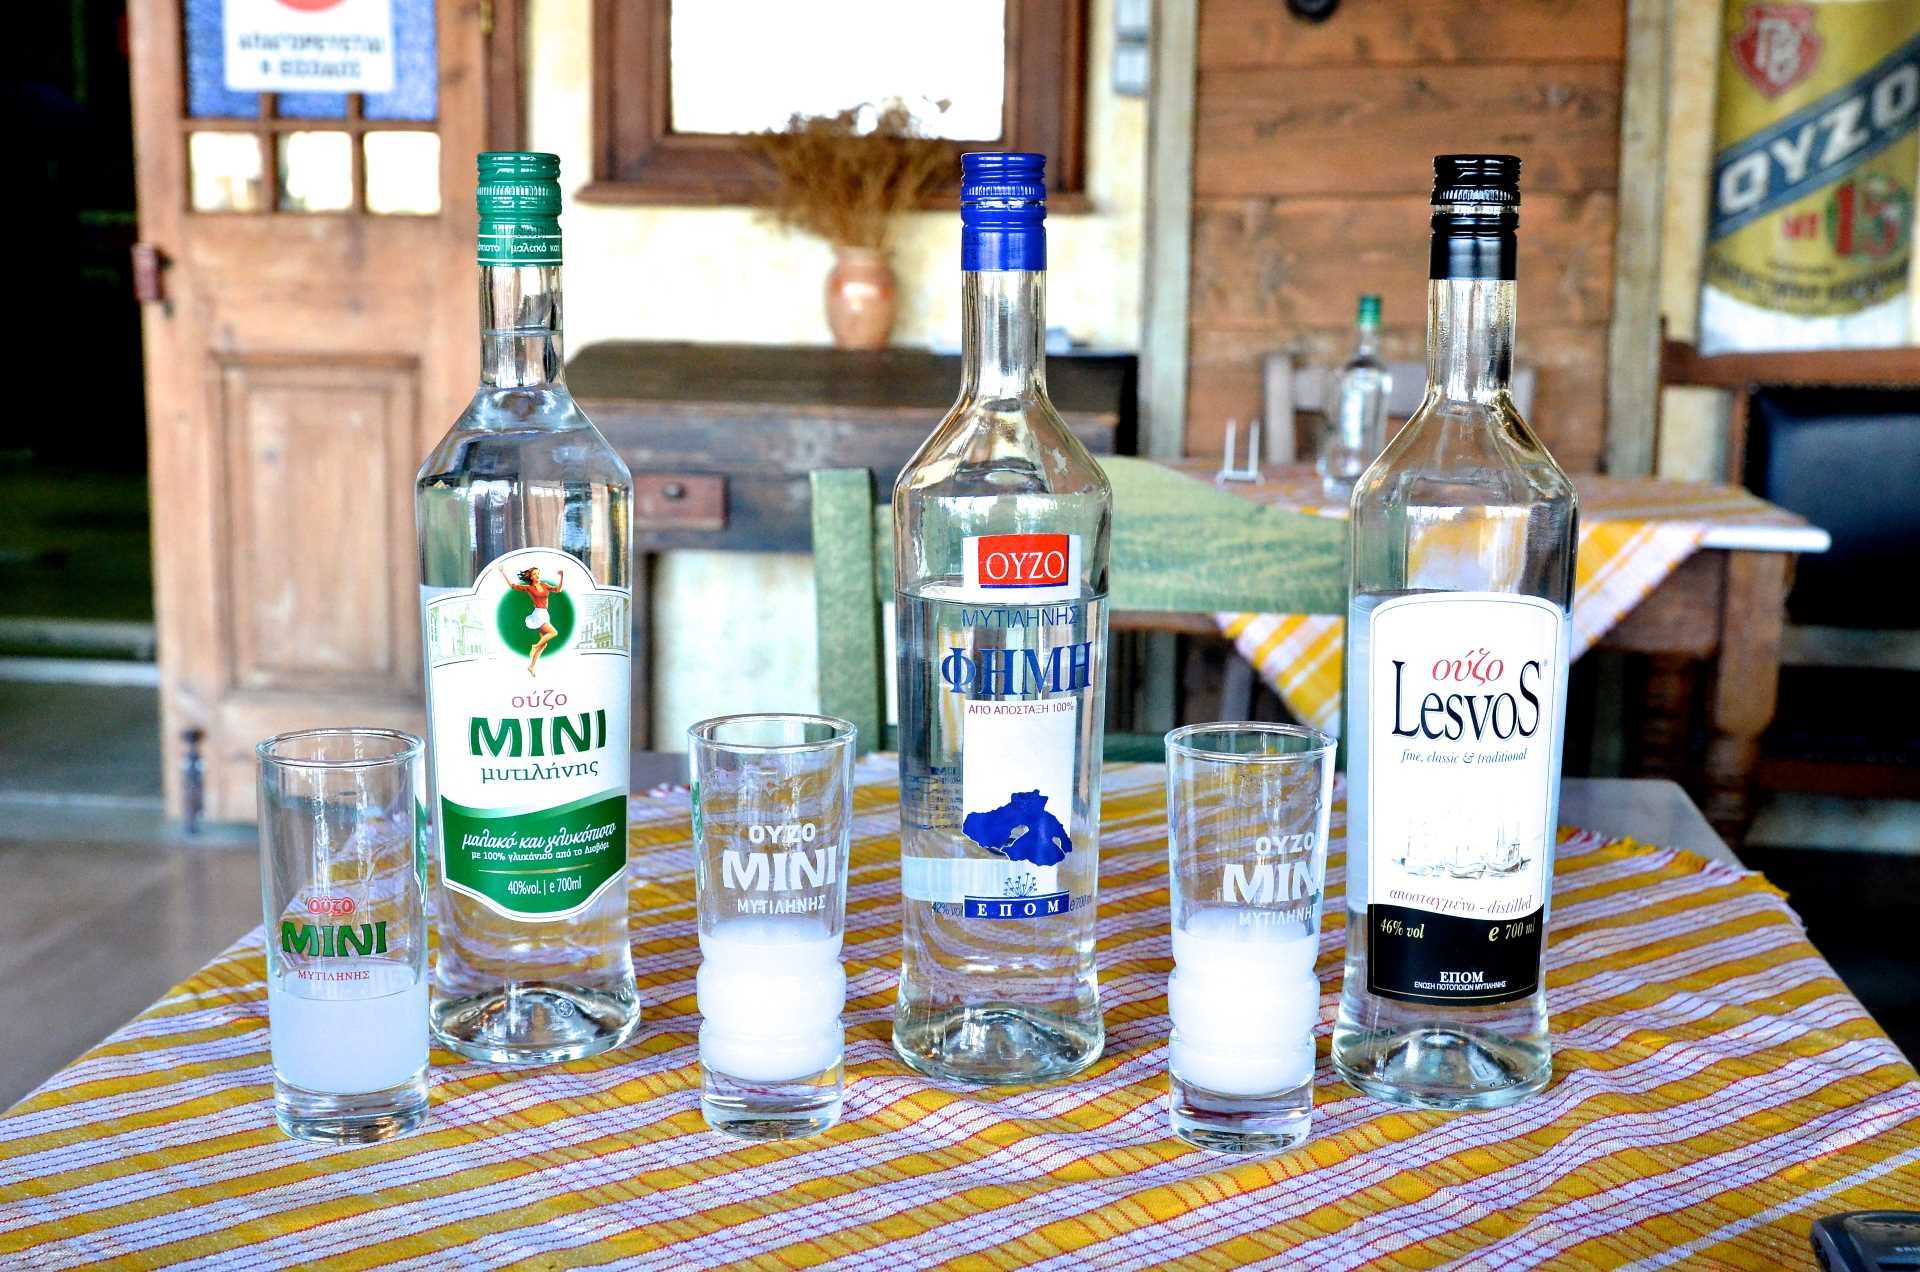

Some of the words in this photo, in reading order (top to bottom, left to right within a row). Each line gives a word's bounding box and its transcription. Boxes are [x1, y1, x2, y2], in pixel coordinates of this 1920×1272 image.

[1718, 63, 1919, 214] ΟΥΖΟ
[985, 550, 1065, 580] ΟΥΖΟ
[961, 606, 1079, 628] ΜΥΤΙΛΗΝΗΣ
[941, 641, 1093, 695] ΦΗΜΗ
[1431, 648, 1504, 686] ούζο
[511, 689, 568, 710] ούζο
[968, 705, 991, 715] ΑΠΟ
[994, 704, 1049, 715] ΑΠΟΣΤΑΞΗ
[1052, 702, 1075, 713] 100%
[468, 709, 607, 758] MINI
[1400, 749, 1424, 764] fine,
[1427, 751, 1460, 764] classic
[1462, 752, 1475, 764] &
[1477, 747, 1528, 764] traditional
[480, 760, 599, 784] μυτιλήνης
[461, 829, 517, 850] μαλακό
[519, 835, 546, 849] και
[749, 823, 816, 844] ΟΥΖΟ
[1255, 832, 1316, 855] ΟΥΖΟ
[472, 852, 481, 861] με
[484, 851, 506, 862] 100%
[508, 851, 553, 863] γλυκάνισο
[556, 848, 572, 859] από
[574, 848, 583, 856] το
[722, 846, 838, 892] MINI
[737, 895, 826, 915] ΜΥΤΙΛΗΝΗΣ
[977, 900, 1060, 917] ΕΠΟΜ
[281, 921, 388, 957] MINI
[1380, 918, 1404, 936] 46%
[1406, 924, 1425, 939] vol
[1487, 926, 1500, 942] e
[1505, 921, 1524, 940] 700
[298, 969, 370, 981] ΜΥΤΙΛΗΝΗΣ
[1439, 971, 1485, 984] ΕΠΟΜ
